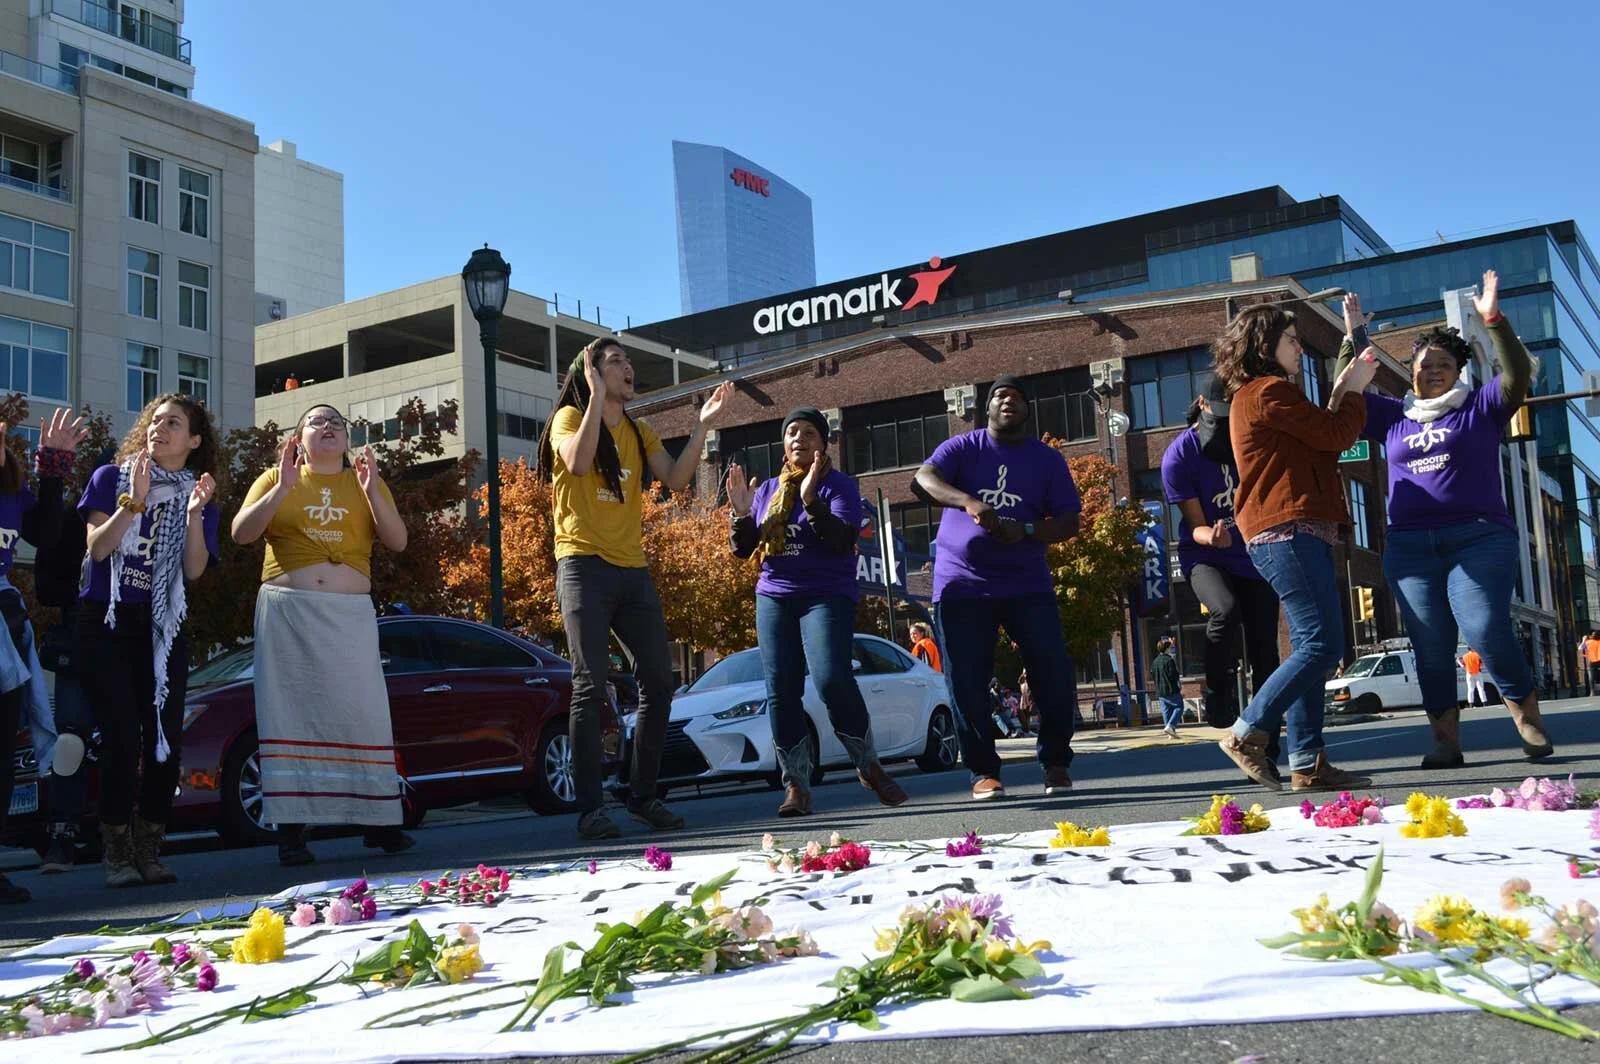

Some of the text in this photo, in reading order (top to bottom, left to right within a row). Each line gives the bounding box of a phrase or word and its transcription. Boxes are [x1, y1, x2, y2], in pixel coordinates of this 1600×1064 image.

[730, 168, 769, 197] FMC
[753, 273, 903, 335] aramark
[1407, 453, 1451, 468] UPROOTED
[1418, 462, 1446, 473] RISING
[121, 566, 152, 583] UPROO
